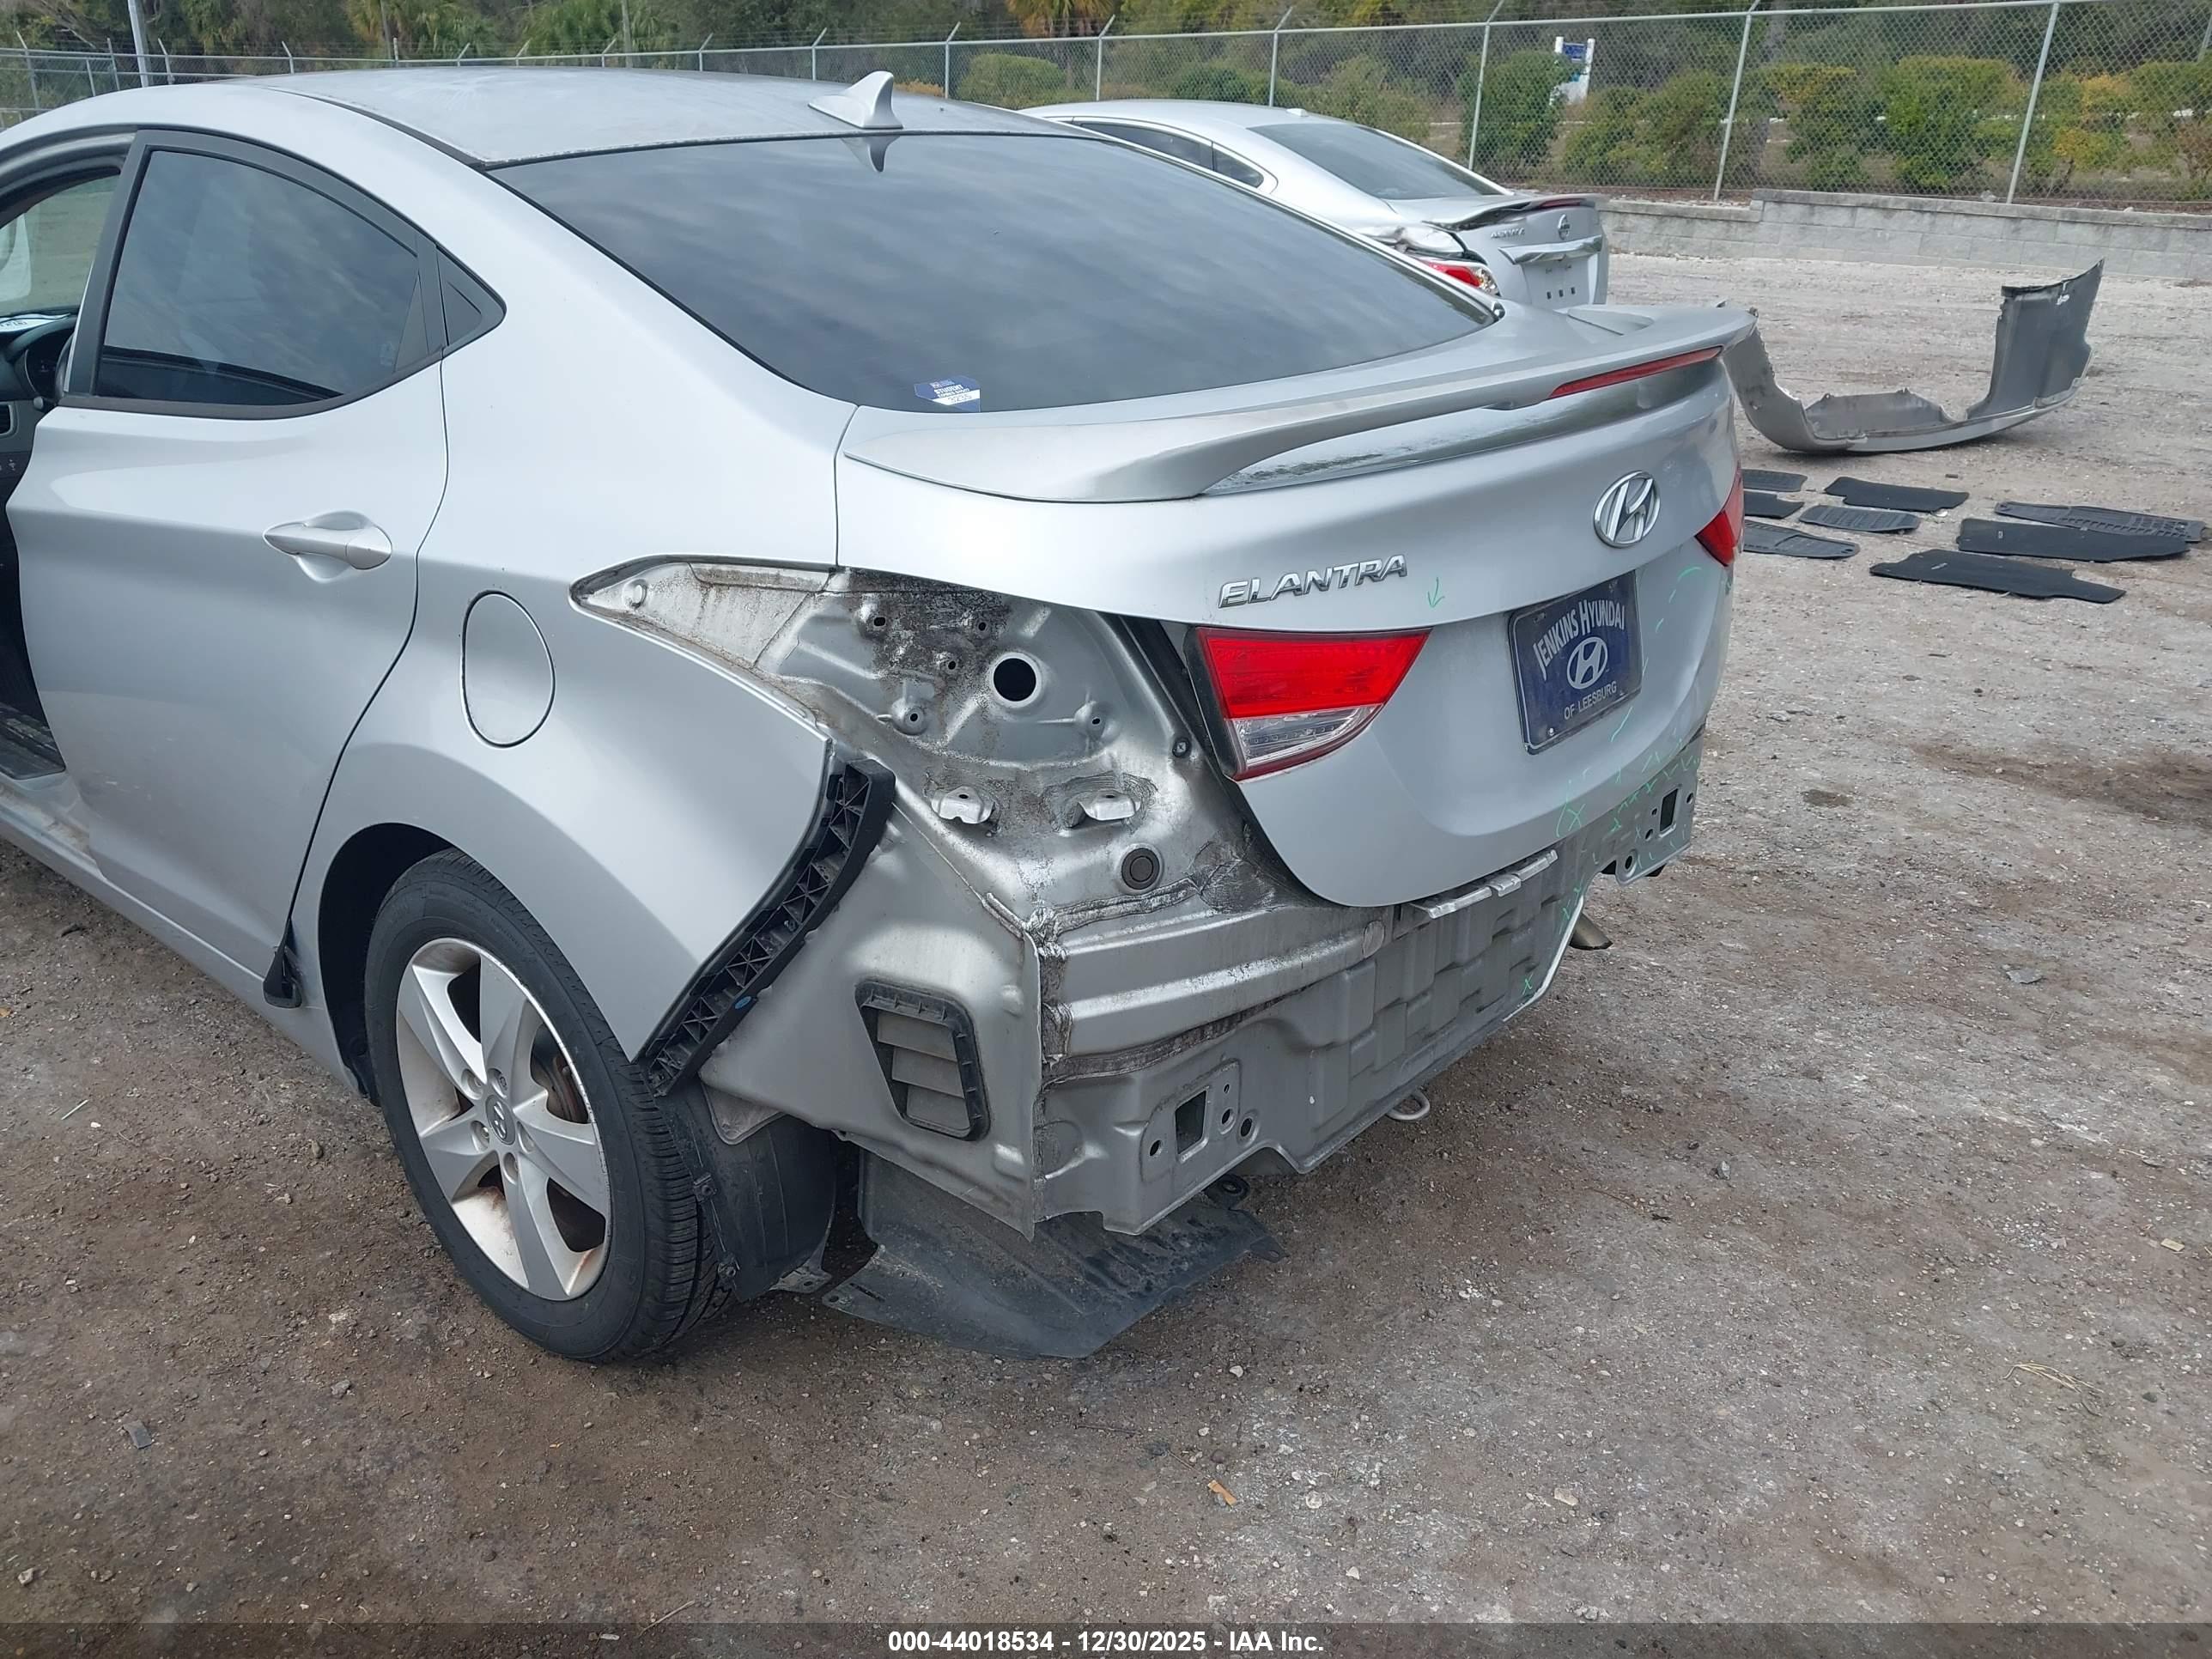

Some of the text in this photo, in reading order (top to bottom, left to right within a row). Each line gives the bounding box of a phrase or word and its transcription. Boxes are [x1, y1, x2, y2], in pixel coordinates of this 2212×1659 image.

[1218, 554, 1407, 609] ELANTRA
[1533, 599, 1625, 681] JENKINS HYUNDAI
[1564, 681, 1617, 720] OF LEESBURG
